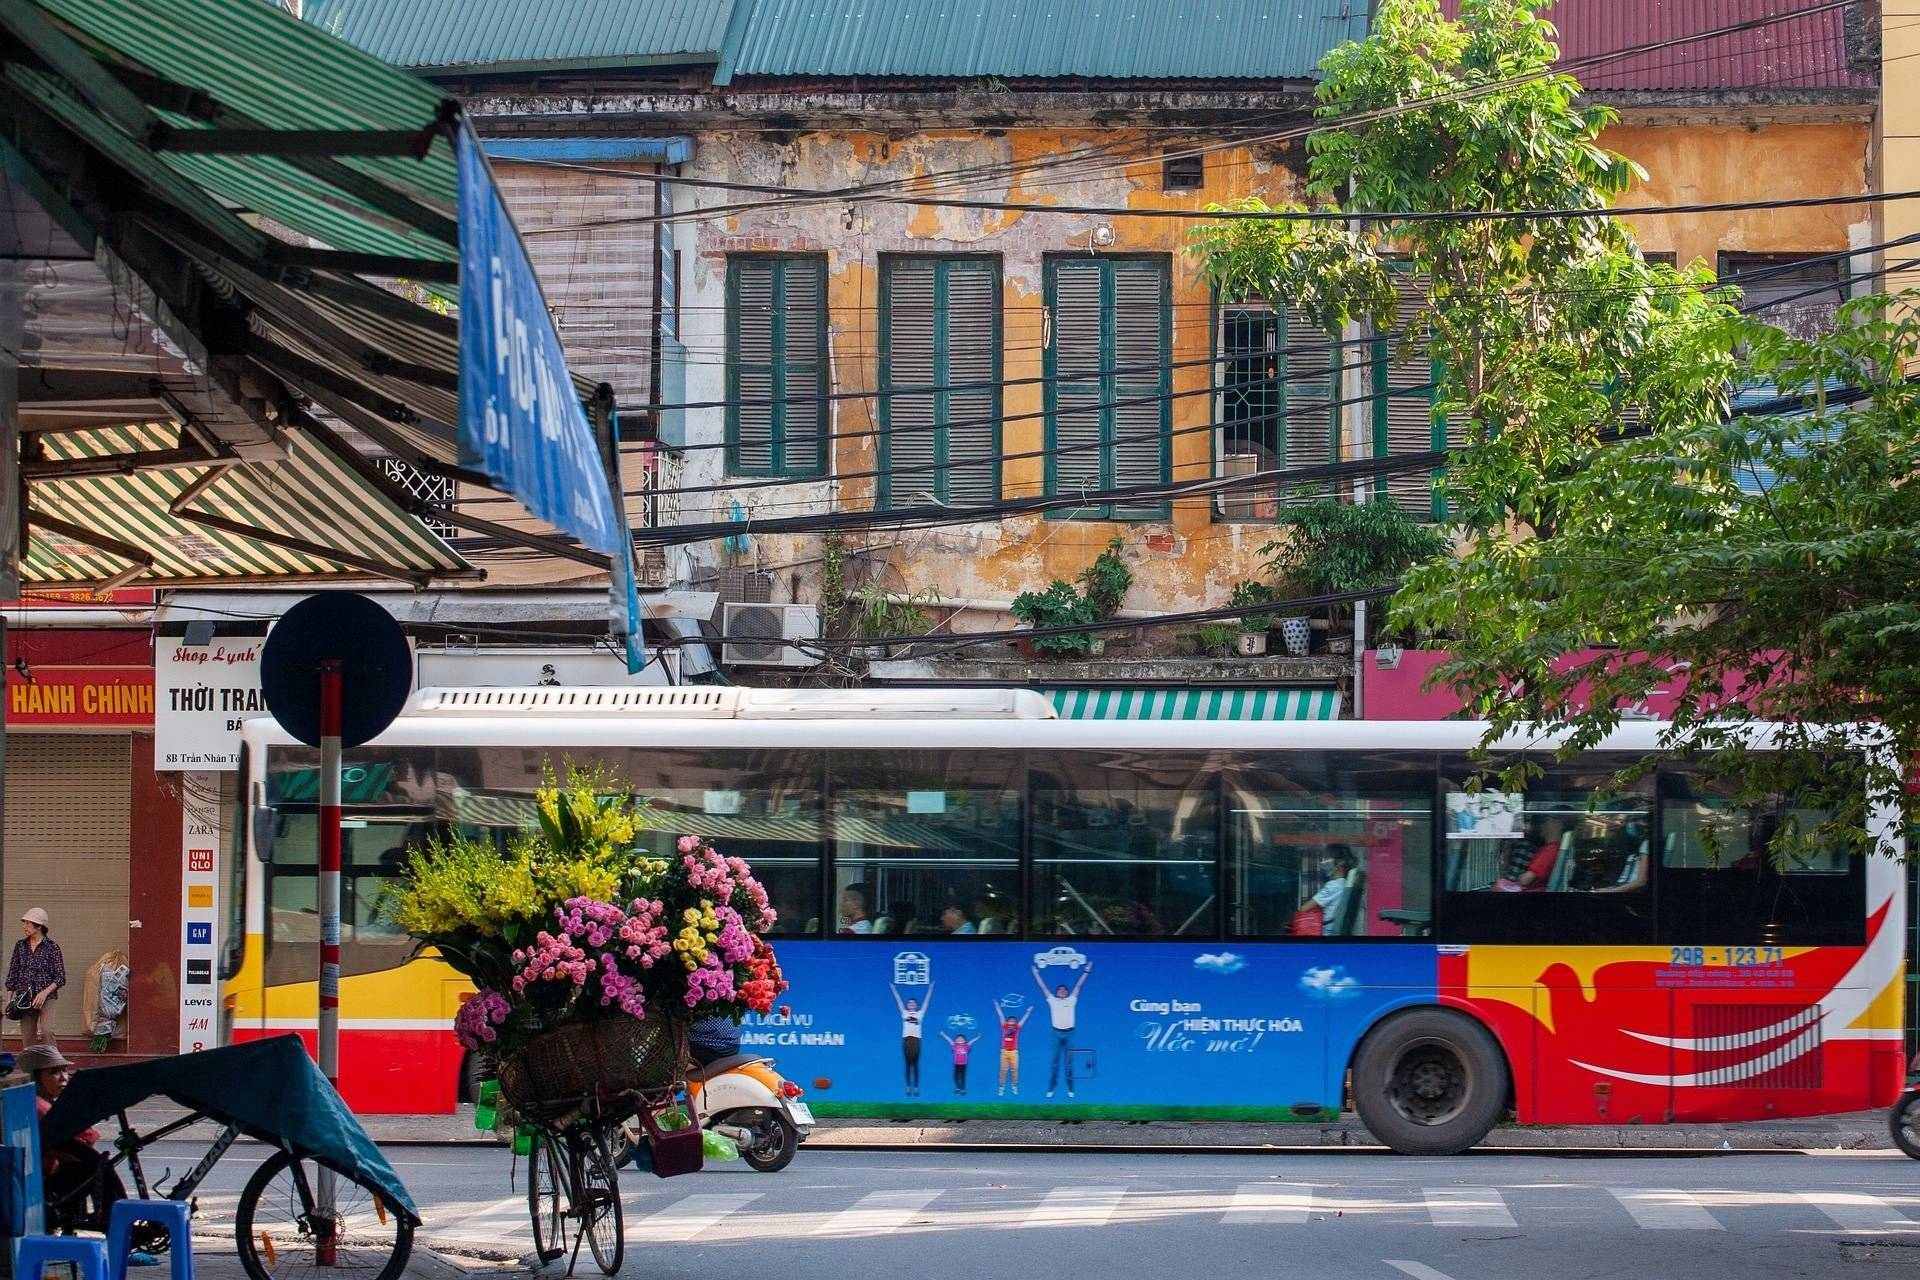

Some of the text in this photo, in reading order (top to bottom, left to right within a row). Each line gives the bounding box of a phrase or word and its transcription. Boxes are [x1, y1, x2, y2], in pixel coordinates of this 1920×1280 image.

[172, 647, 209, 664] Shop
[12, 677, 154, 714] HÀNH CHÍNH
[169, 682, 215, 711] THỜI
[188, 824, 214, 835] ZARA
[191, 851, 211, 861] UNI
[190, 860, 211, 871] QLO
[192, 928, 207, 938] GAP
[1183, 1016, 1220, 1035] HIỆN
[1221, 1017, 1267, 1035] THỰC
[740, 1030, 845, 1046] ÀNG CÁ NHÂN
